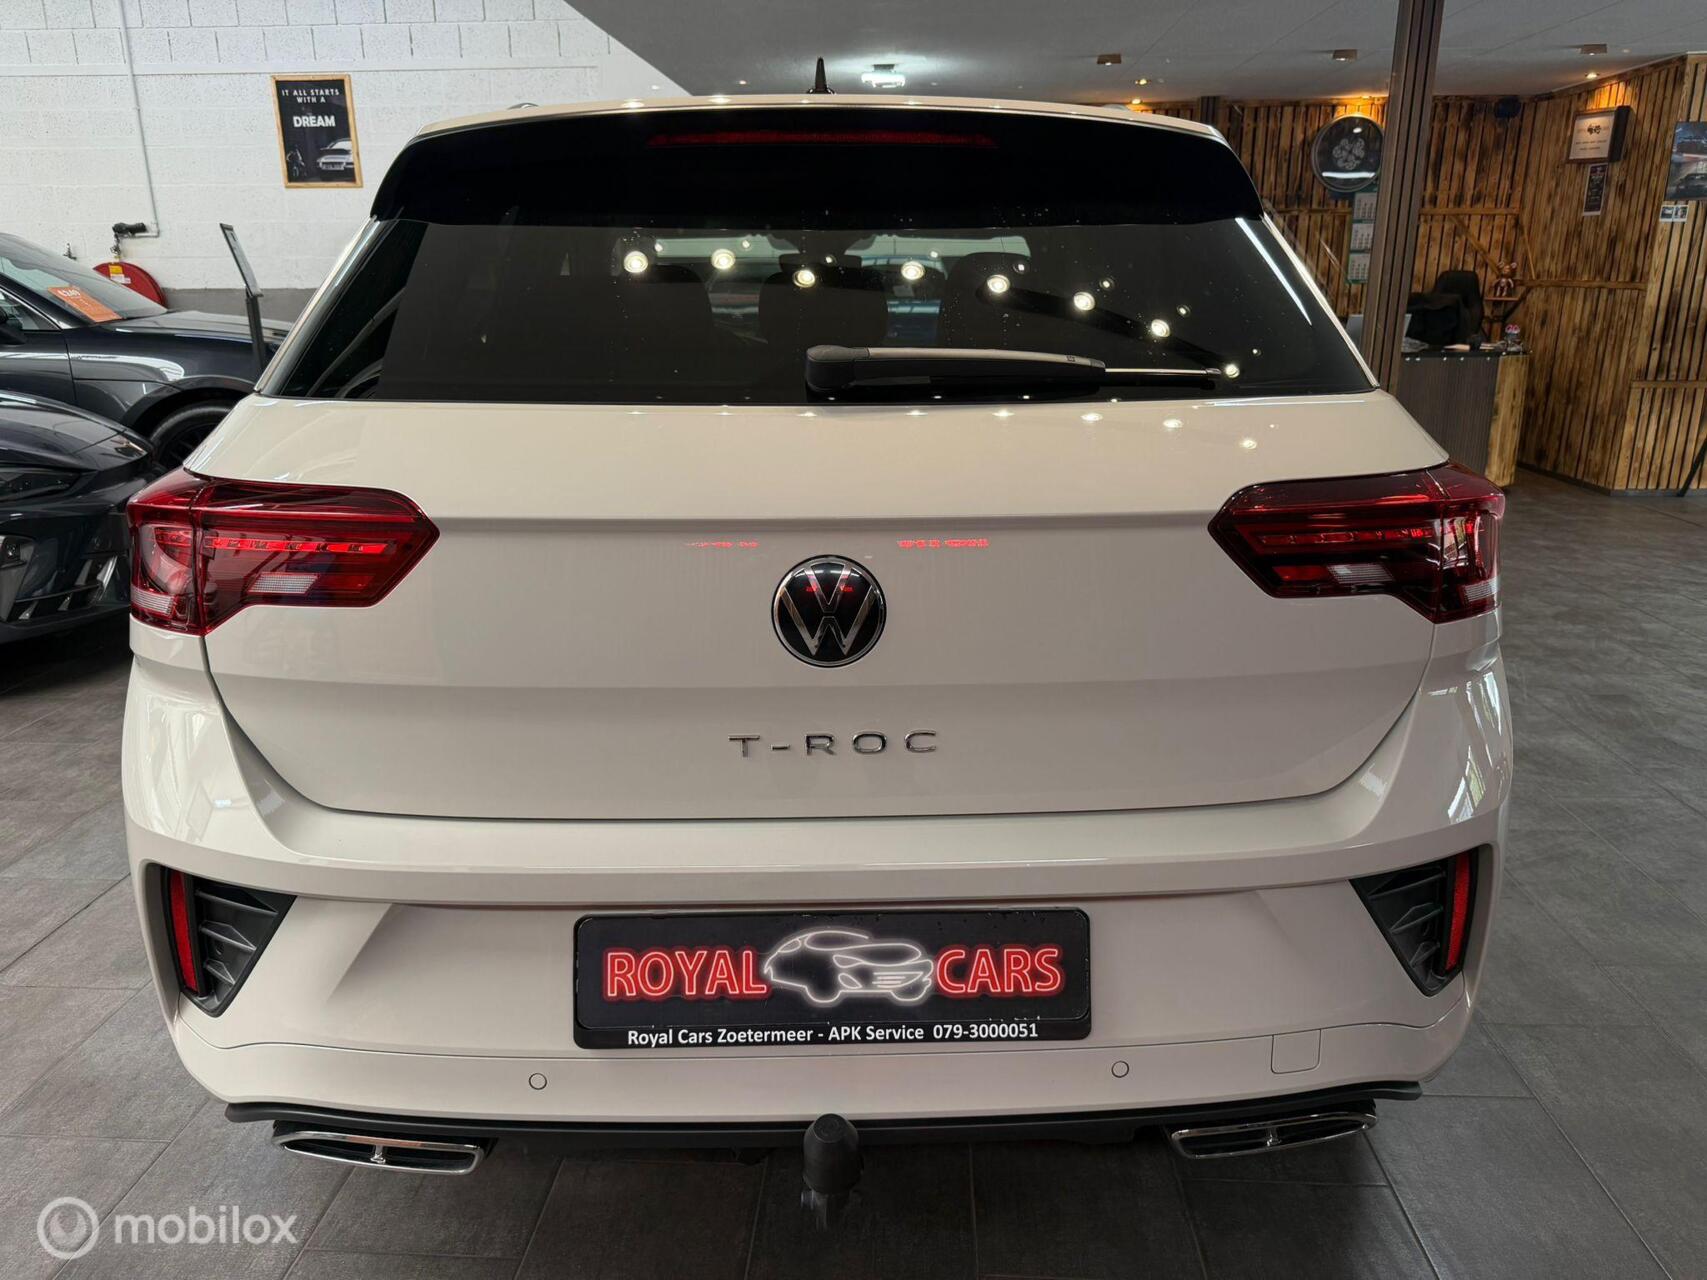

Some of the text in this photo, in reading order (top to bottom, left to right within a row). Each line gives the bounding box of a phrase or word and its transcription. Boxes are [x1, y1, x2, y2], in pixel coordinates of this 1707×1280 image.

[293, 115, 336, 127] DREAM
[728, 729, 938, 757] T-ROC
[605, 946, 1063, 998] ROYAL CARS
[627, 1028, 674, 1048] Royal
[677, 1027, 713, 1044] Cars
[717, 1027, 814, 1043] Zoetermeer
[828, 1026, 863, 1042] APK
[866, 1024, 924, 1041] Service
[933, 1023, 1039, 1040] 079-3000051
